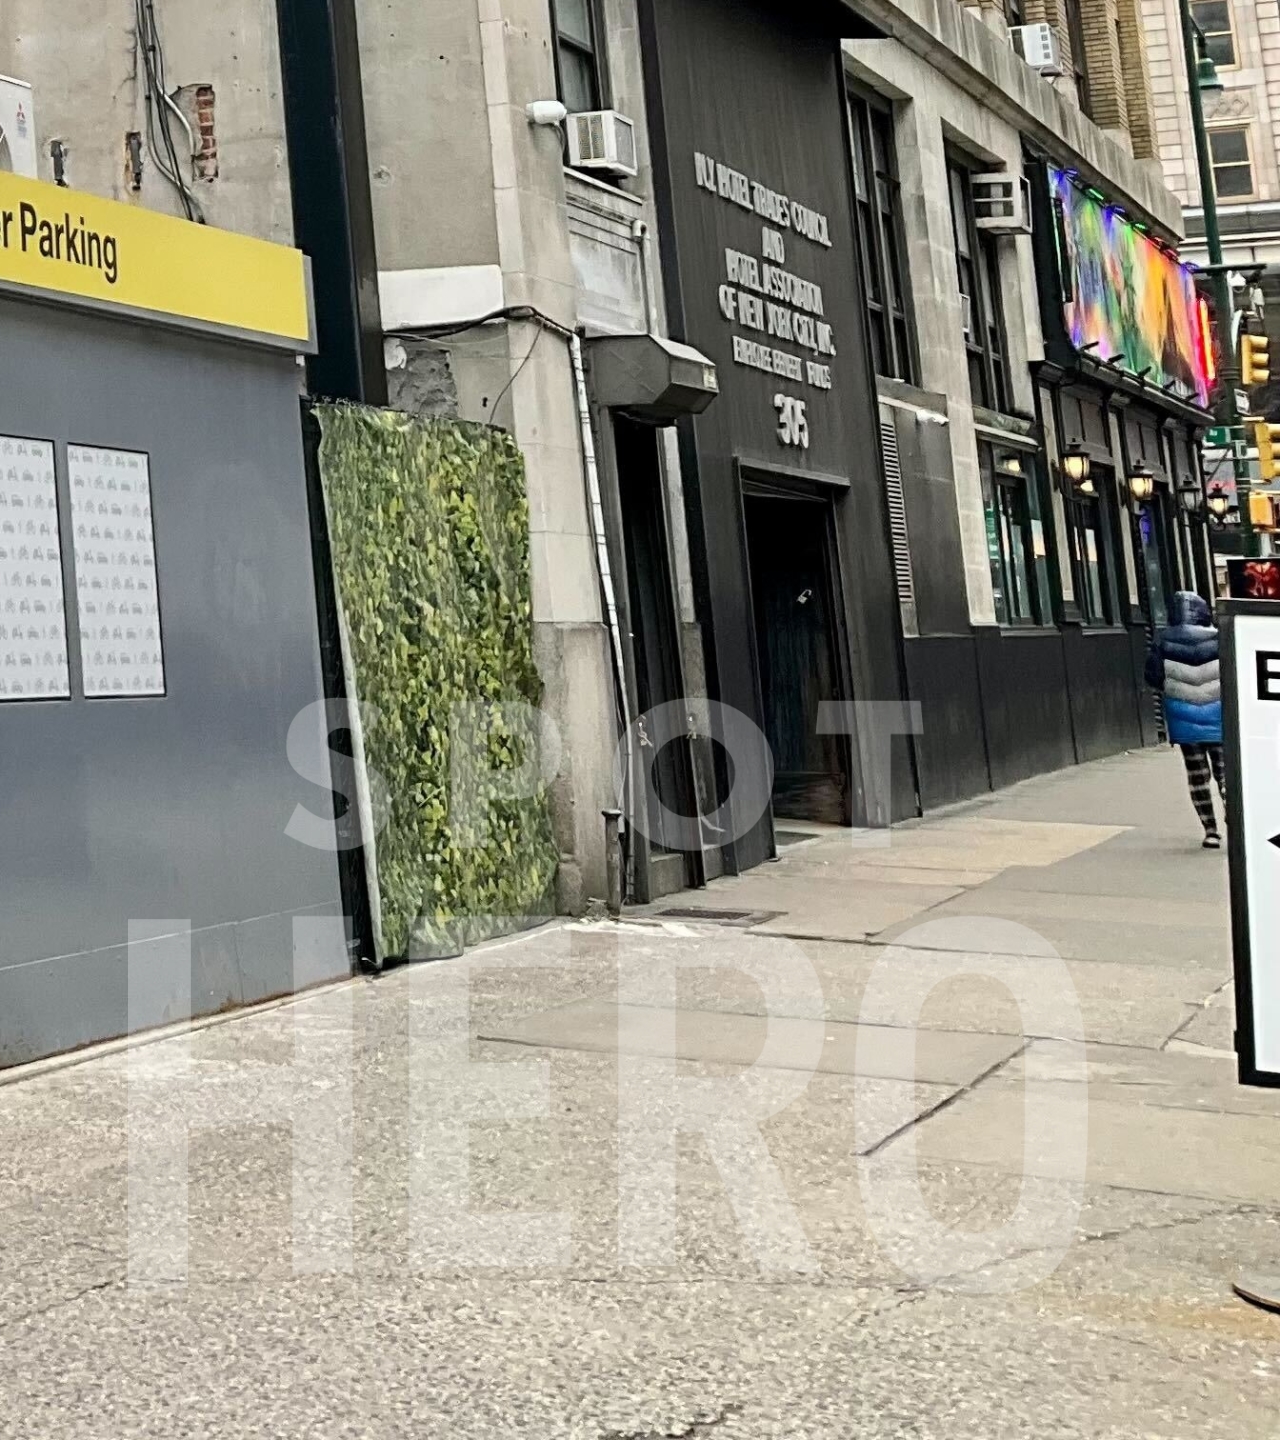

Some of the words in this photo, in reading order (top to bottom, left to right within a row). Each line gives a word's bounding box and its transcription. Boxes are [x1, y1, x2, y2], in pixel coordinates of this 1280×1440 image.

[716, 163, 754, 211] HOTEL
[750, 180, 791, 228] TRADES
[19, 209, 119, 285] Parking
[725, 248, 764, 293] HOTEL
[761, 226, 786, 264] AND
[718, 284, 737, 320] OF
[737, 291, 765, 331] NEW
[765, 301, 795, 342] YORK
